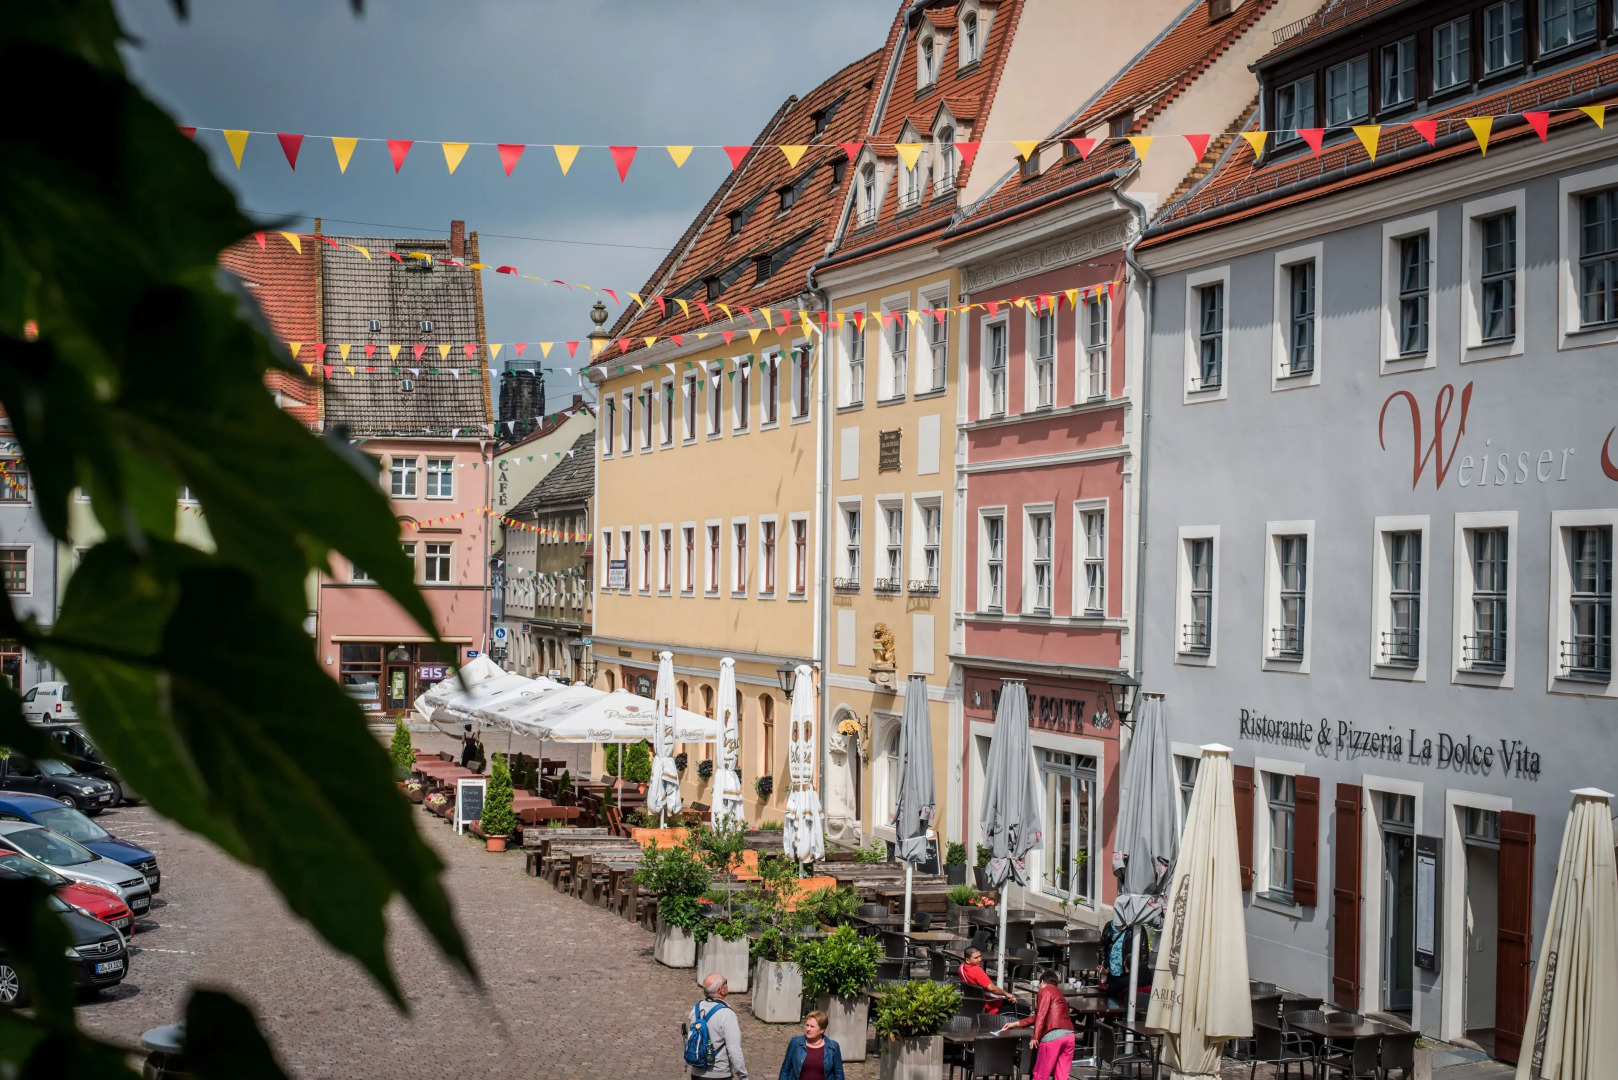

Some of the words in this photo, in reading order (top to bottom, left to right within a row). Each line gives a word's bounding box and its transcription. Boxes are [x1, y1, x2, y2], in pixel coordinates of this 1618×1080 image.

[1379, 381, 1575, 491] Weisser
[421, 667, 442, 678] EIS
[1039, 694, 1085, 728] BOLTE
[1240, 708, 1313, 743] Ristorante
[1317, 717, 1332, 746] &
[1338, 719, 1403, 756] Pizzeria
[1409, 728, 1432, 759] La
[1437, 732, 1494, 768] Dolce
[1500, 739, 1541, 774] Vita
